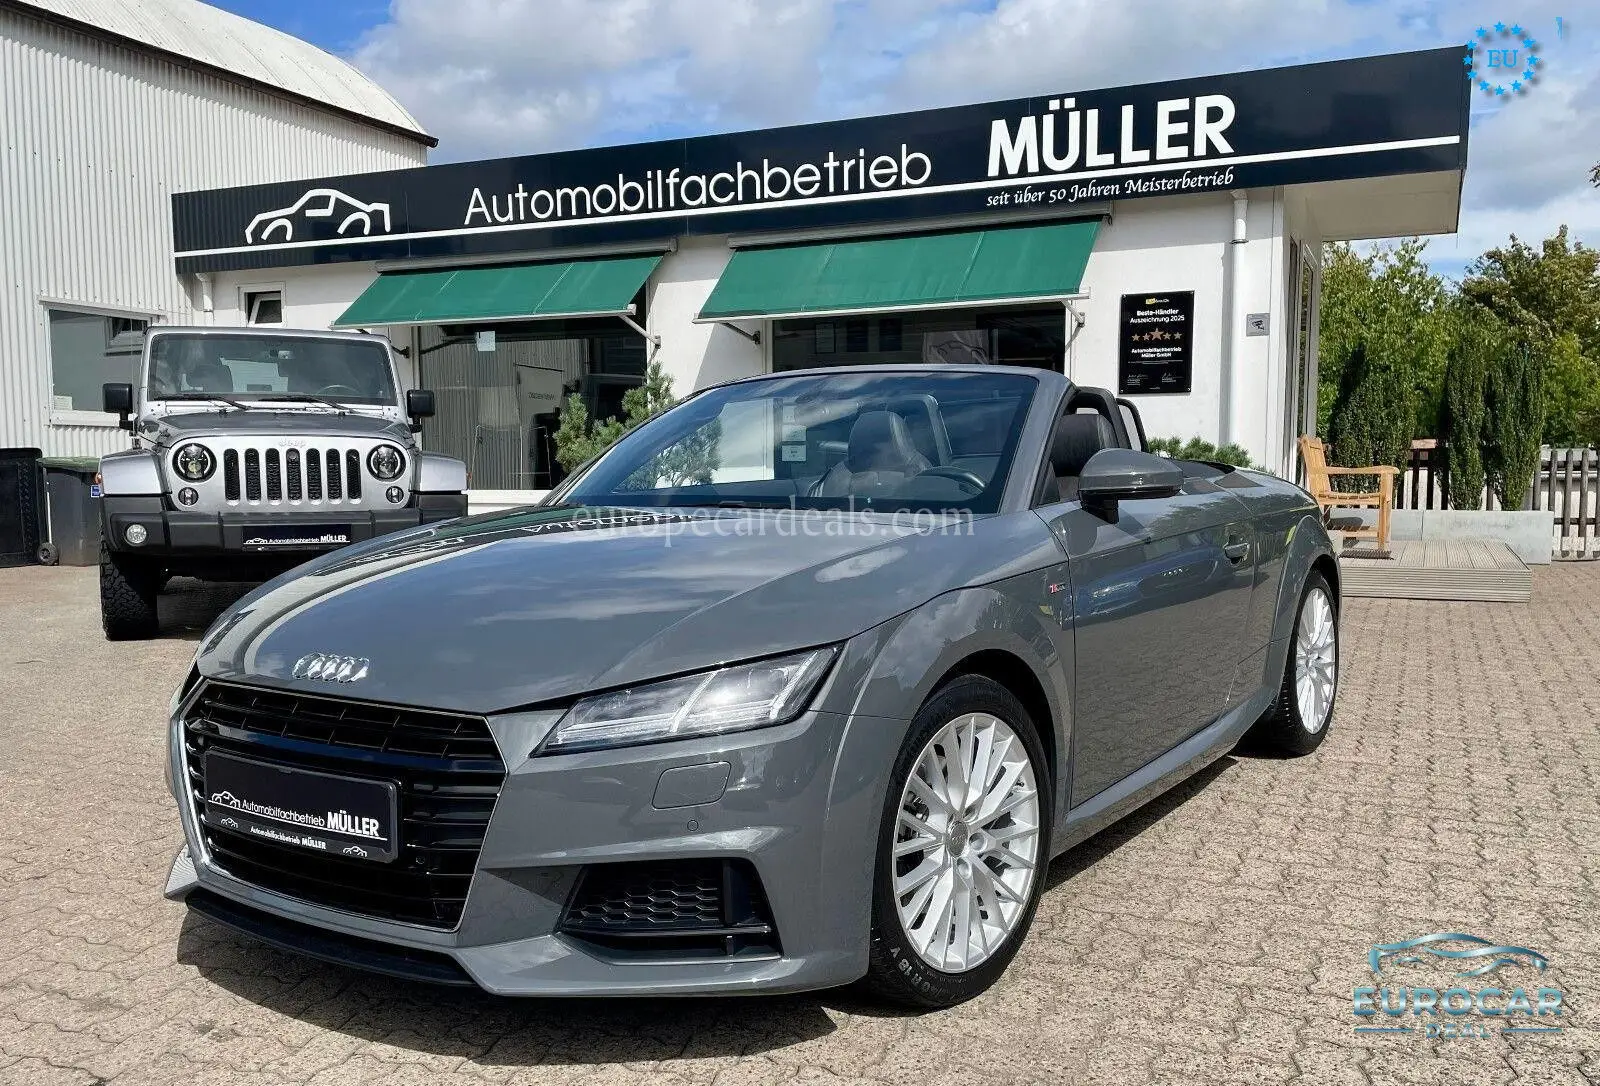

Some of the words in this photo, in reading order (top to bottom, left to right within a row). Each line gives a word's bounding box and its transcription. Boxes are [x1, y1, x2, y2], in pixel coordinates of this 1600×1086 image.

[464, 144, 932, 225] Automobilfachbetrieb
[987, 95, 1236, 177] MÜLLER
[986, 190, 1010, 206] seit
[1014, 186, 1046, 204] über
[1049, 188, 1067, 203] 50
[1068, 179, 1120, 202] Jahren
[1124, 166, 1235, 194] Meisterbetrieb
[320, 533, 347, 542] MÜLLER
[241, 799, 325, 827] Automobilfachbetrieb
[327, 810, 380, 837] MÜLLER
[250, 826, 301, 845] Automobilfachbetrieb
[301, 836, 327, 850] MÜLLER
